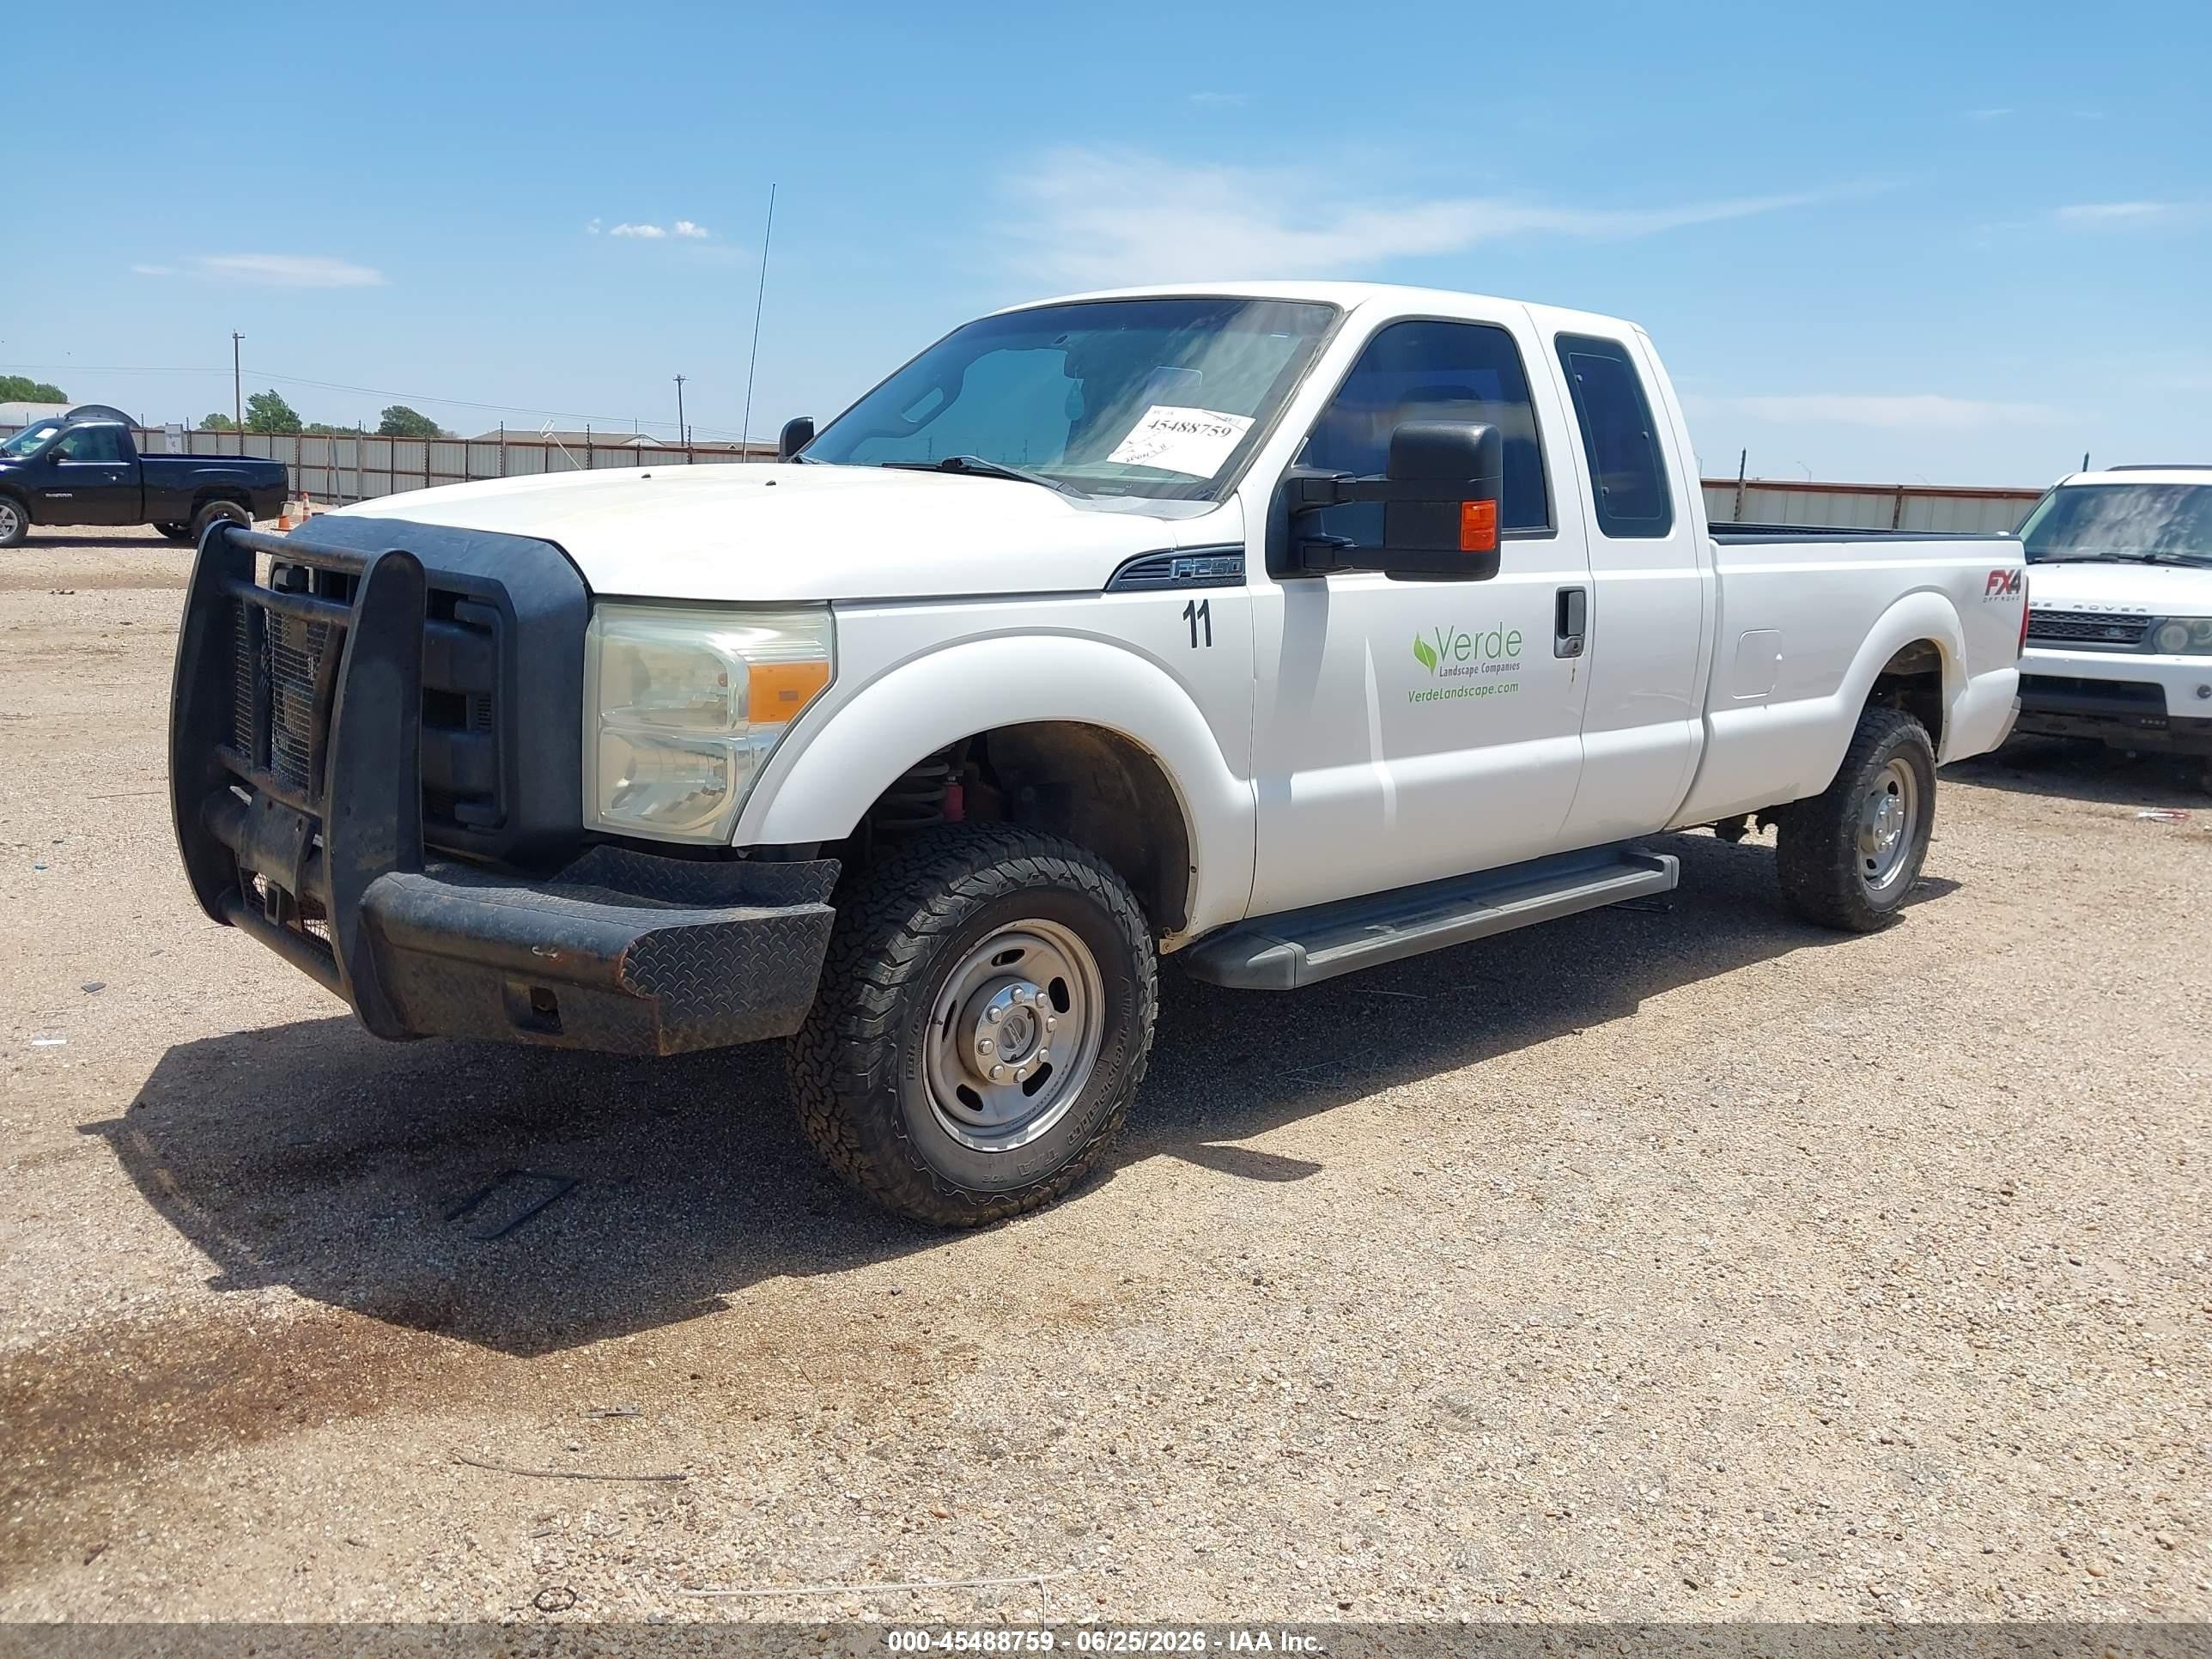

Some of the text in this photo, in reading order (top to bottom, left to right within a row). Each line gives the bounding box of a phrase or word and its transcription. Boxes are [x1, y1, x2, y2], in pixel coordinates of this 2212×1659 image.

[1147, 419, 1232, 437] 45488759
[1170, 557, 1244, 580] F-250
[1985, 569, 2021, 596] FX4
[2072, 604, 2147, 612] ROVER
[1182, 599, 1212, 648] 11
[1435, 621, 1522, 662] Verde
[1439, 662, 1520, 678] Landscape Companies
[1408, 683, 1519, 703] VerdeLandscape.com
